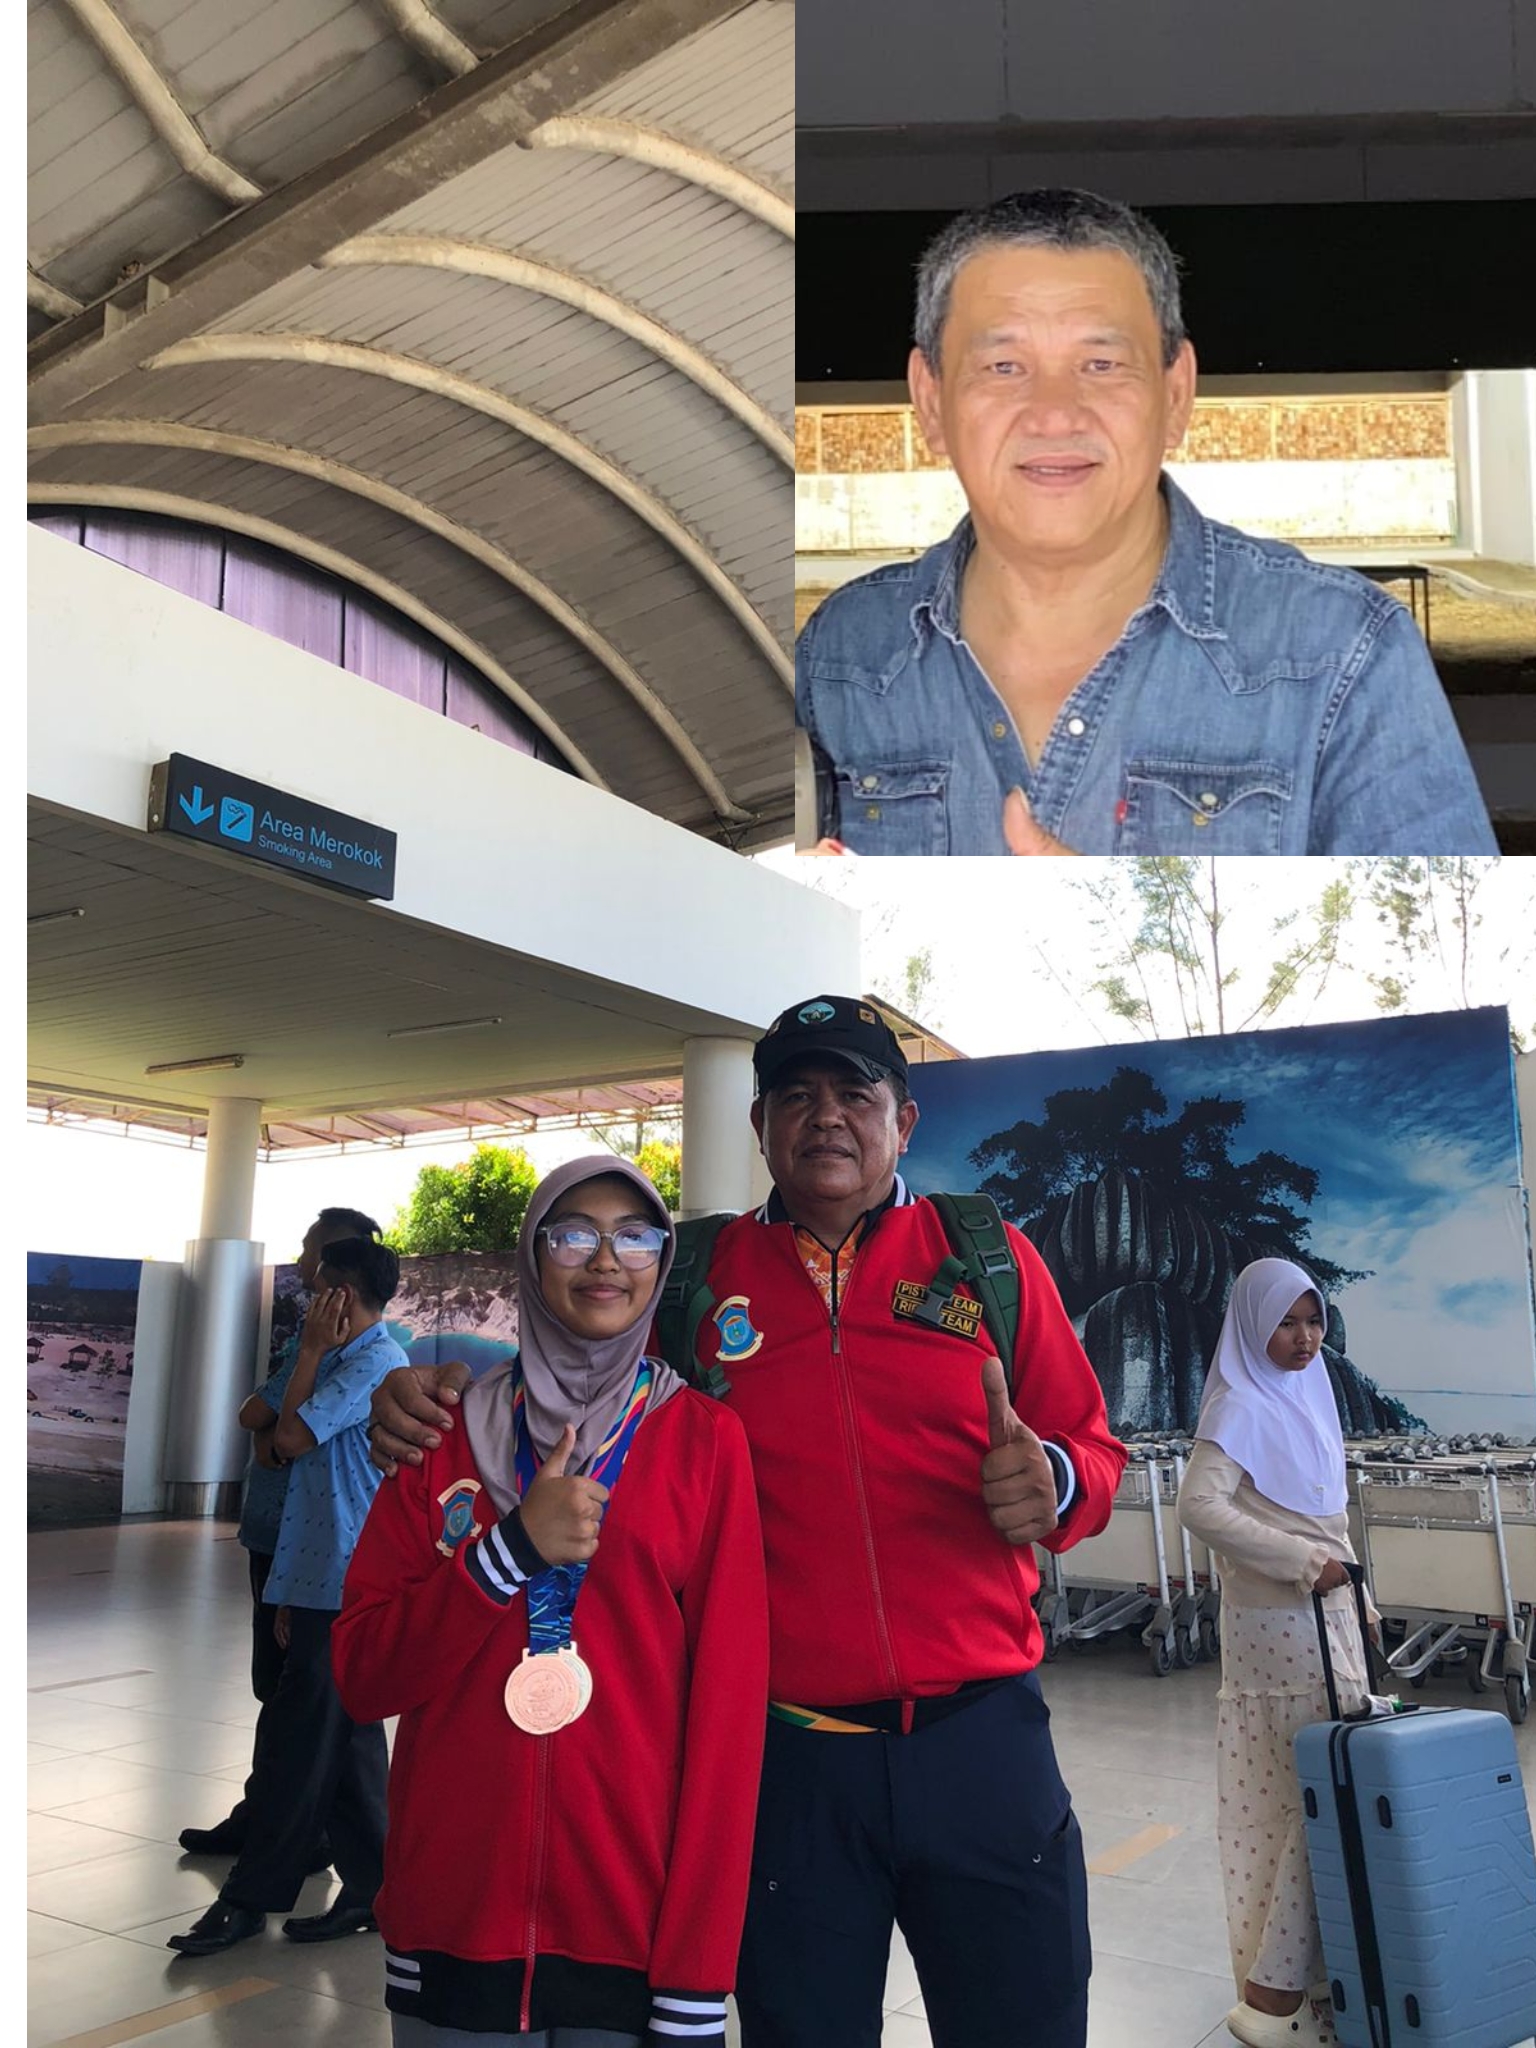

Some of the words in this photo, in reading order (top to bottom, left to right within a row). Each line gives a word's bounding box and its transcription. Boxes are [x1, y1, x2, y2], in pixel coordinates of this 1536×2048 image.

[258, 834, 305, 863] Smoking
[307, 851, 333, 869] Area
[260, 810, 304, 842] Area
[310, 826, 383, 870] Merokok
[901, 1284, 928, 1298] PIST
[953, 1297, 978, 1315] EAM
